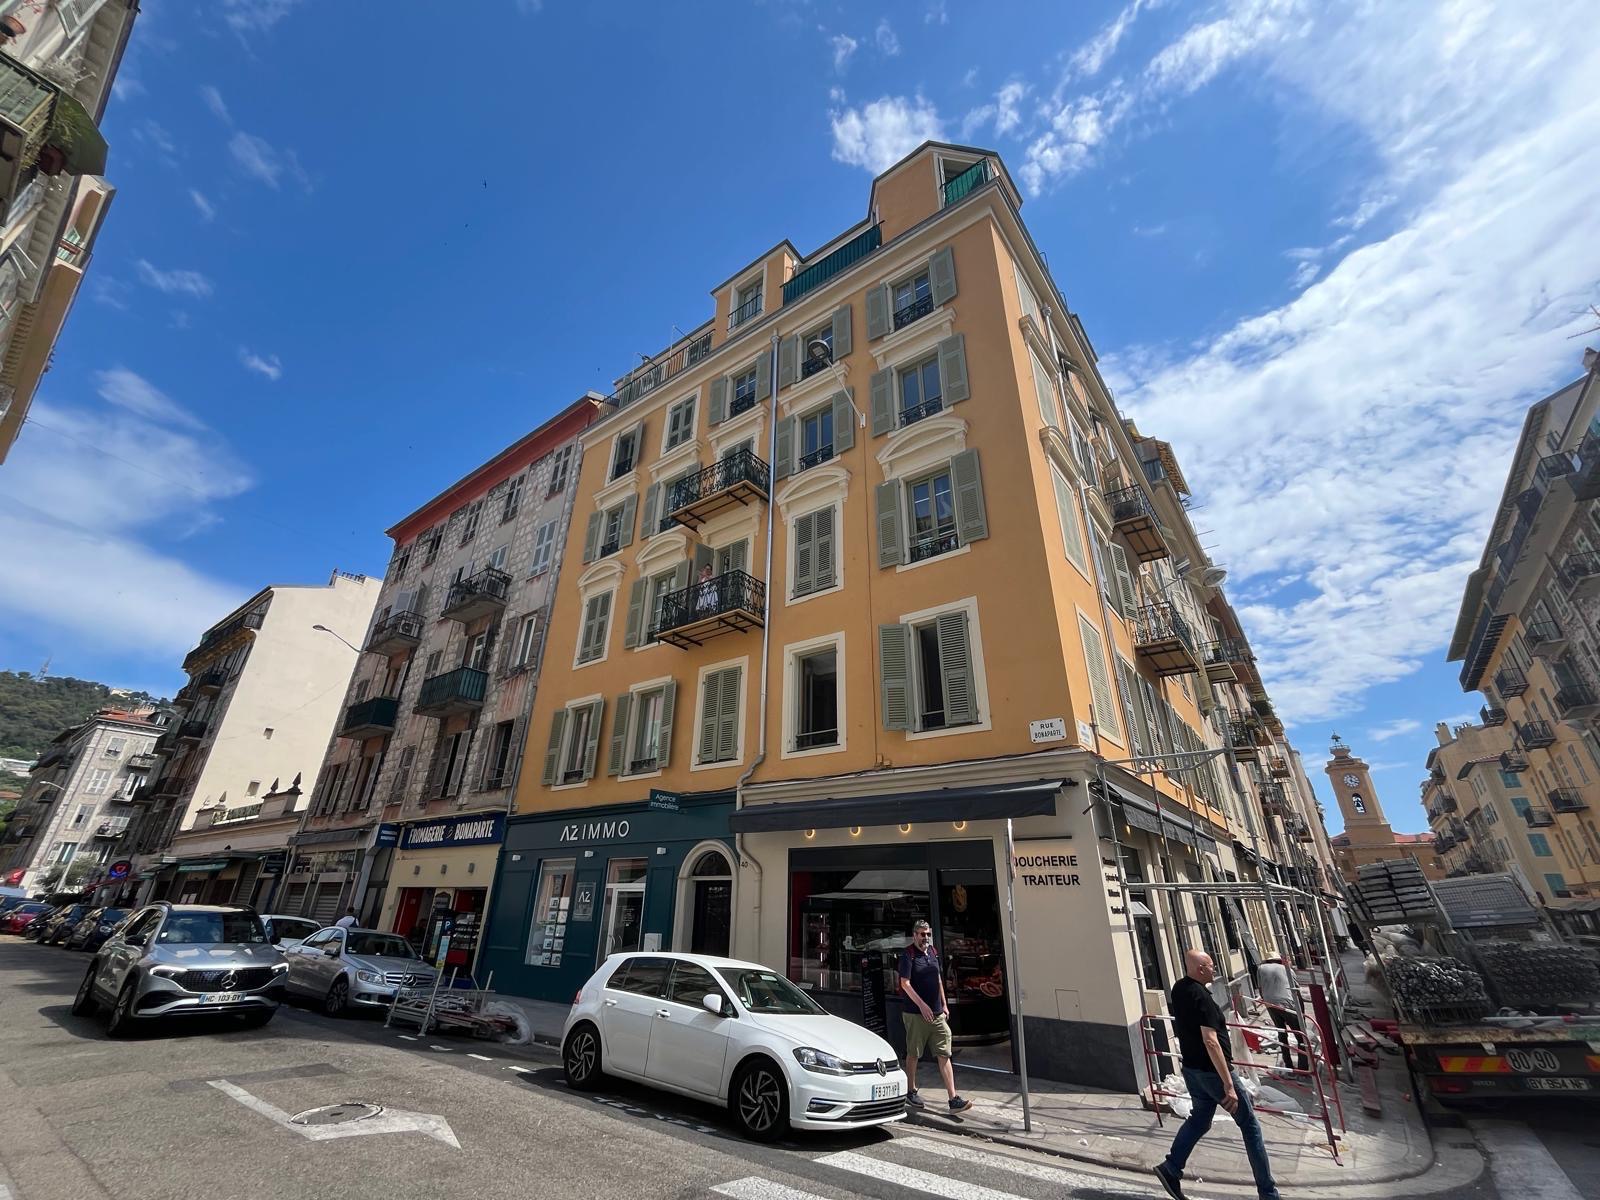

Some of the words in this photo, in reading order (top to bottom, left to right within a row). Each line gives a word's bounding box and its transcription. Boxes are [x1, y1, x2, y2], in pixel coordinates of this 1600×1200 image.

[1034, 730, 1062, 739] BONAPARTE
[655, 793, 676, 803] Agence
[408, 825, 446, 844] FROMAGERIE
[453, 820, 495, 841] BONAPARTE
[1022, 874, 1080, 886] TRAITEUR
[1509, 1051, 1530, 1070] 80
[1533, 1050, 1556, 1070] 90
